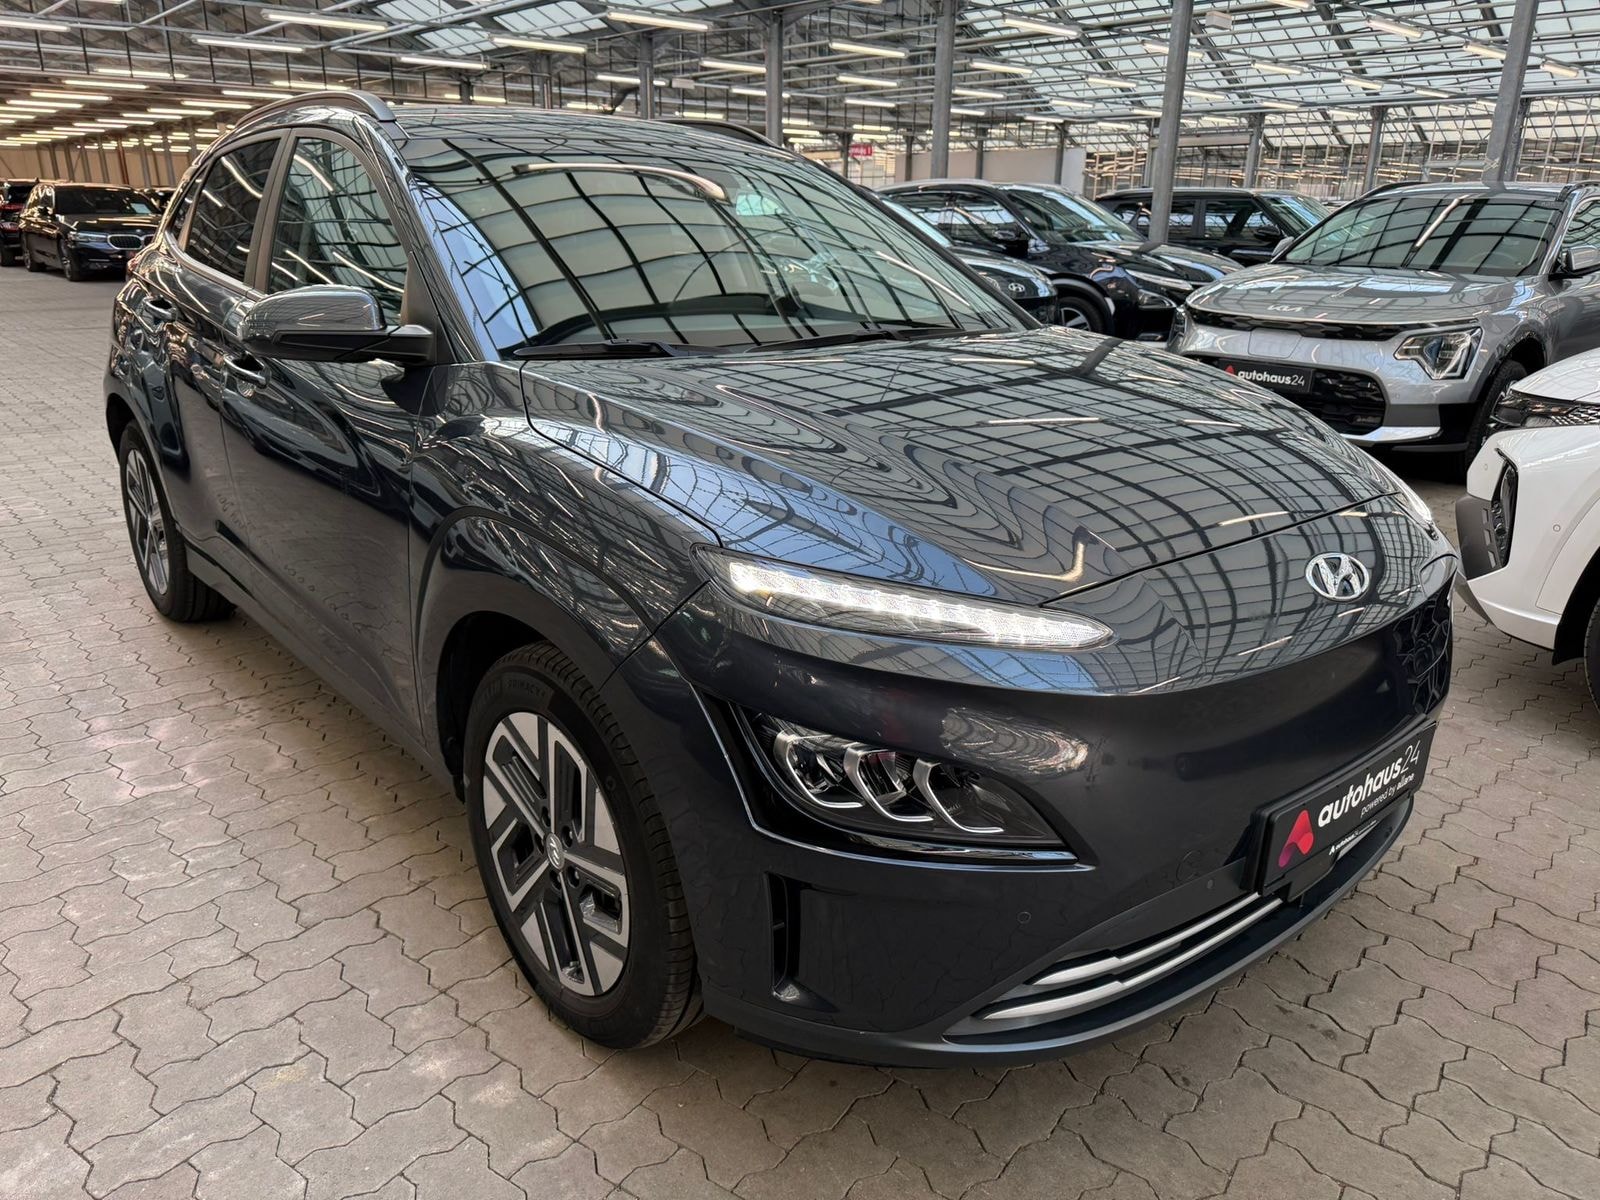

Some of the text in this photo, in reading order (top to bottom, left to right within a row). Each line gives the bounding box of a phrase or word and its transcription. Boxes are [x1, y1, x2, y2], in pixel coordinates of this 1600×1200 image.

[1237, 369, 1305, 387] autohaus24
[1317, 740, 1421, 828] autohaus24
[1360, 787, 1389, 819] powered
